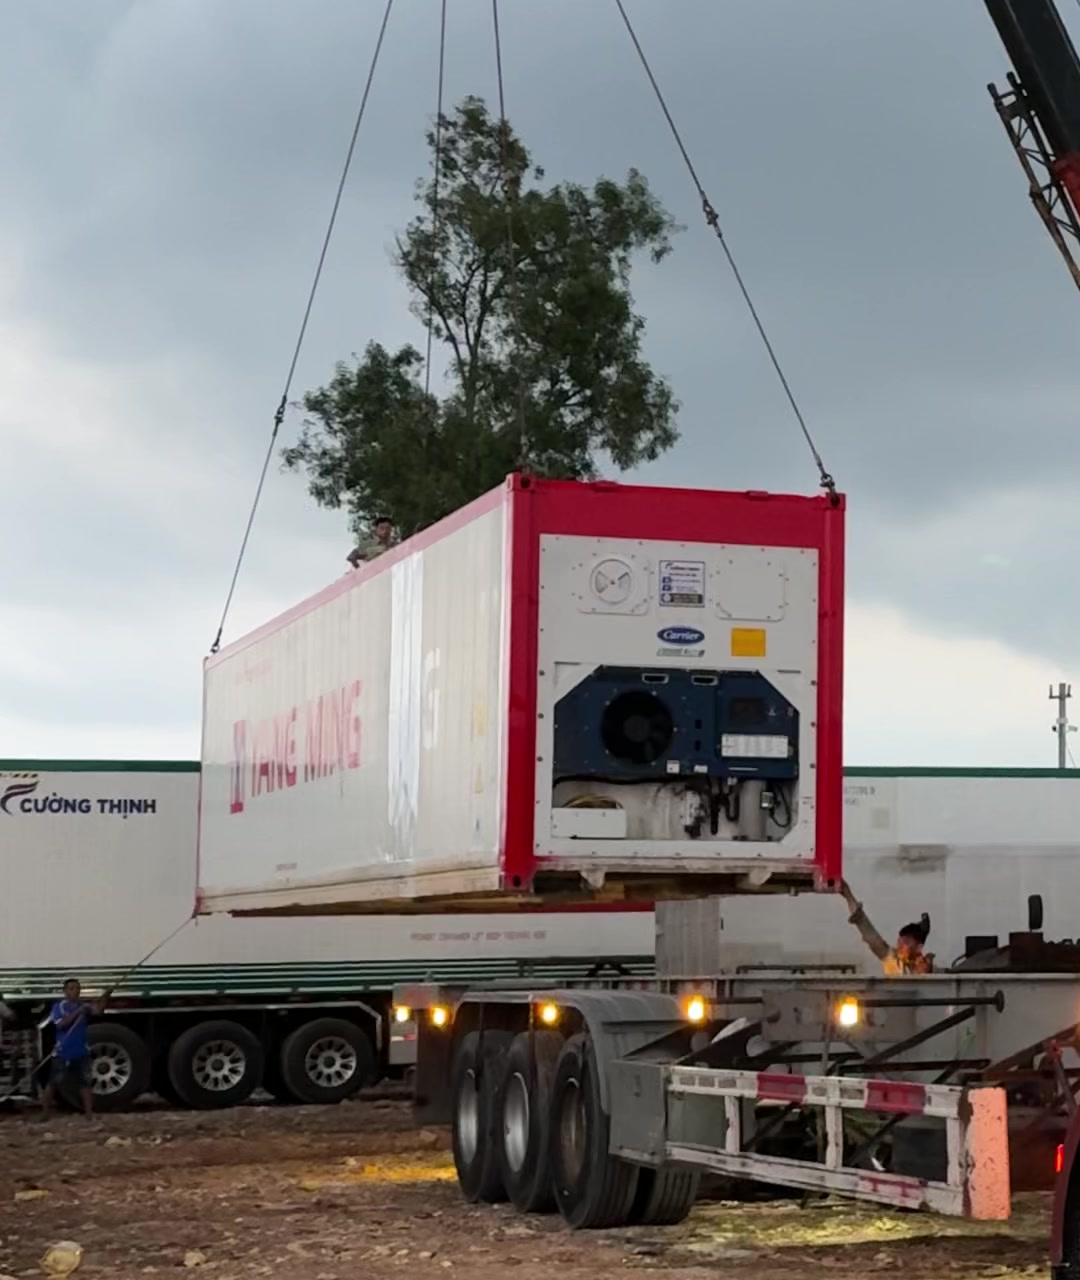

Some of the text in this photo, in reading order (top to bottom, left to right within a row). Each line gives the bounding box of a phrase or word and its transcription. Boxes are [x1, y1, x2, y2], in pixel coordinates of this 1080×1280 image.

[663, 630, 701, 641] Carrier
[20, 792, 157, 819] CƯỜNG THỊNH
